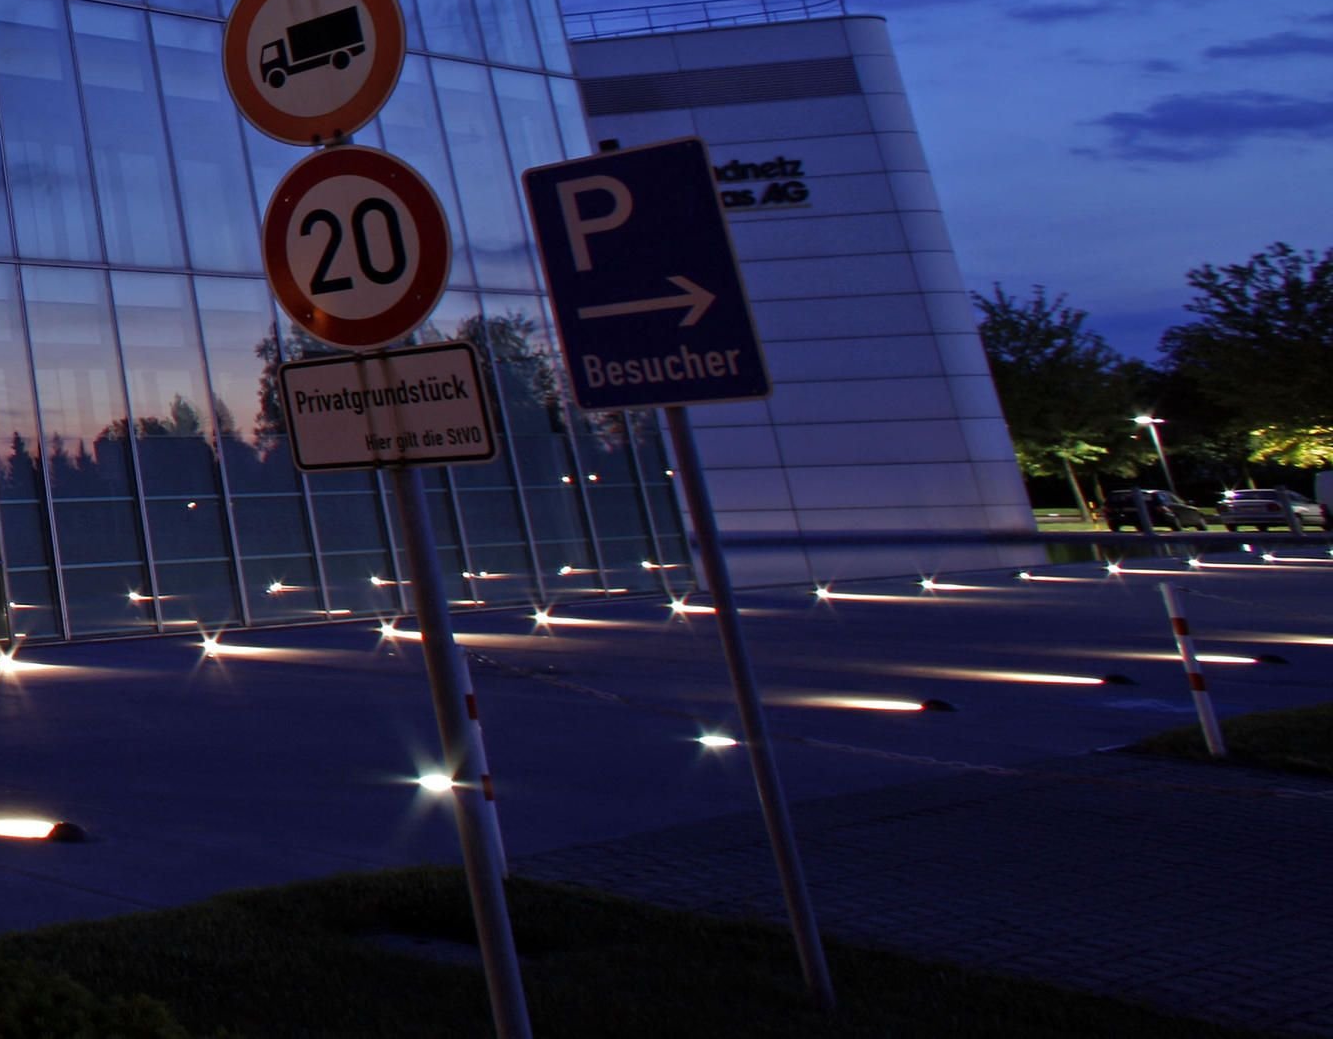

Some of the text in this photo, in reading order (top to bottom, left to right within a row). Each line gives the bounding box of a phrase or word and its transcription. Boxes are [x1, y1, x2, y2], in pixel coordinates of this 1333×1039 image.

[761, 181, 810, 204] AG
[556, 175, 633, 272] P
[300, 197, 406, 294] 20
[582, 344, 740, 388] Besucher
[296, 374, 468, 414] Privatgrundstück
[365, 426, 482, 452] Hier gilt die StVO
